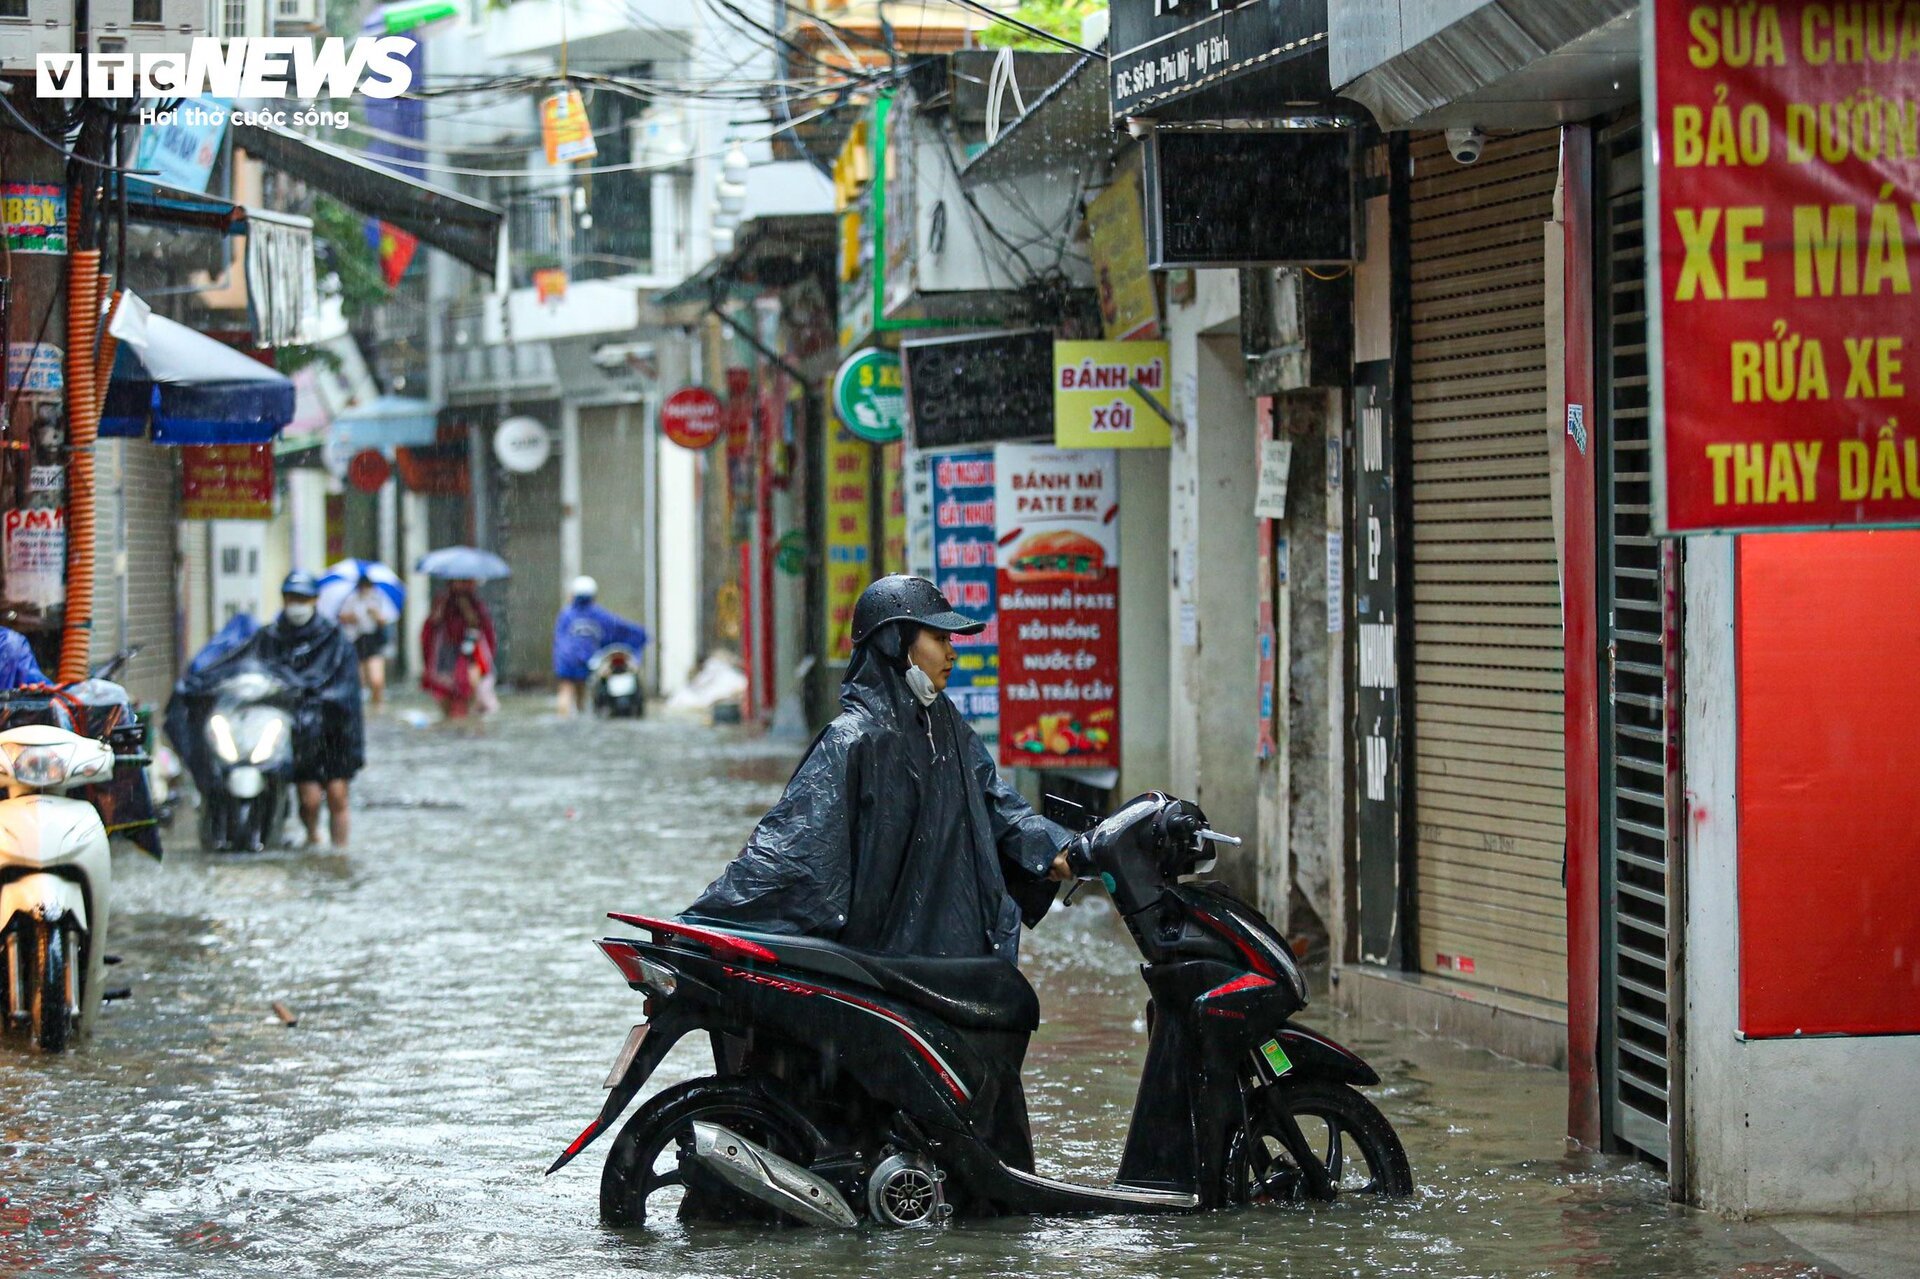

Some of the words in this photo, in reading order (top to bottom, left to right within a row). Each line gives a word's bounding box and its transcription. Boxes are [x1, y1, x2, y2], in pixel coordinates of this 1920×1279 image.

[1673, 84, 1770, 168] BẢO
[1674, 207, 1768, 301] XE
[1793, 182, 1920, 298] MÁ
[1061, 359, 1127, 389] BÁNH
[1135, 357, 1162, 390] MÌ
[1731, 319, 1829, 402] RỬA
[1843, 337, 1904, 399] XE
[1093, 402, 1132, 431] XÔI
[1012, 470, 1070, 490] BÁNH
[1077, 467, 1102, 490] MÌ
[1705, 440, 1822, 505] THAY
[1017, 495, 1063, 512] PATE
[1000, 588, 1049, 610] BÁNH
[1074, 593, 1115, 609] PATE
[1018, 619, 1049, 640] XÔI
[1051, 619, 1100, 640] NÓNG
[1023, 650, 1073, 671] NƯỚC
[1074, 650, 1097, 671] ÉP
[1007, 678, 1040, 701] TRÀ
[1042, 678, 1080, 701] TRÁI
[1081, 678, 1114, 701] CÂY
